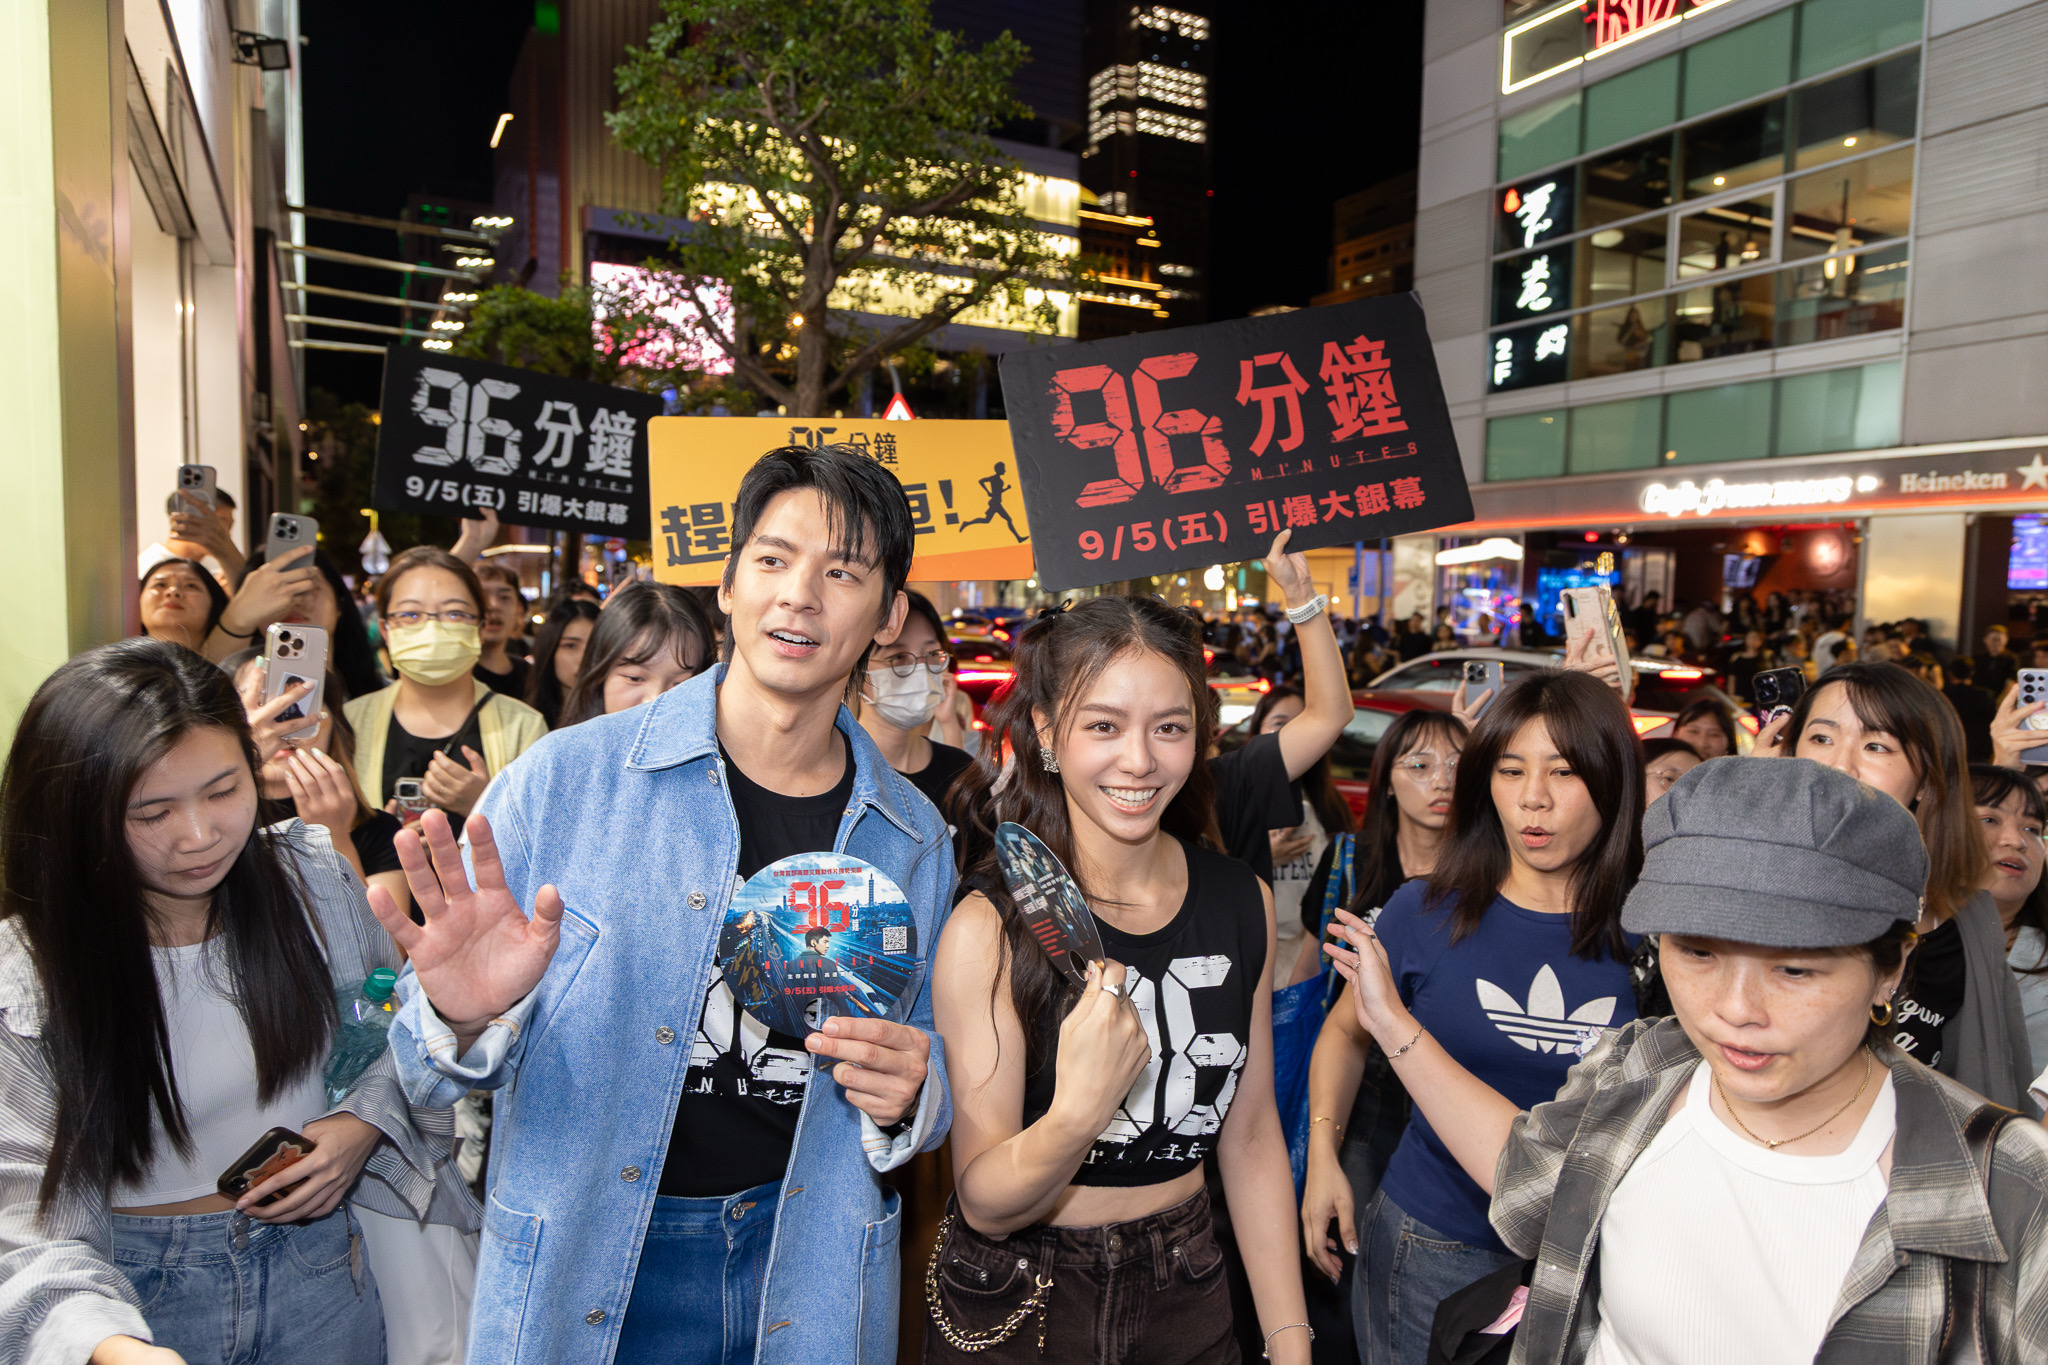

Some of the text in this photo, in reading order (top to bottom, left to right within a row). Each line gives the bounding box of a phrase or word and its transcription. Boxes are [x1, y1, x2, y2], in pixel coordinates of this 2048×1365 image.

[410, 366, 637, 477] 96分鐘
[1046, 334, 1409, 509] 96分鐘
[1250, 441, 1419, 482] MINUTES
[1900, 470, 2008, 493] Heineken
[405, 475, 630, 525] 9/5(五) 引爆大銀幕
[1078, 476, 1427, 561] 9/5(五) 引爆大銀幕
[787, 880, 851, 934] 96
[784, 986, 816, 995] 9/5(五)
